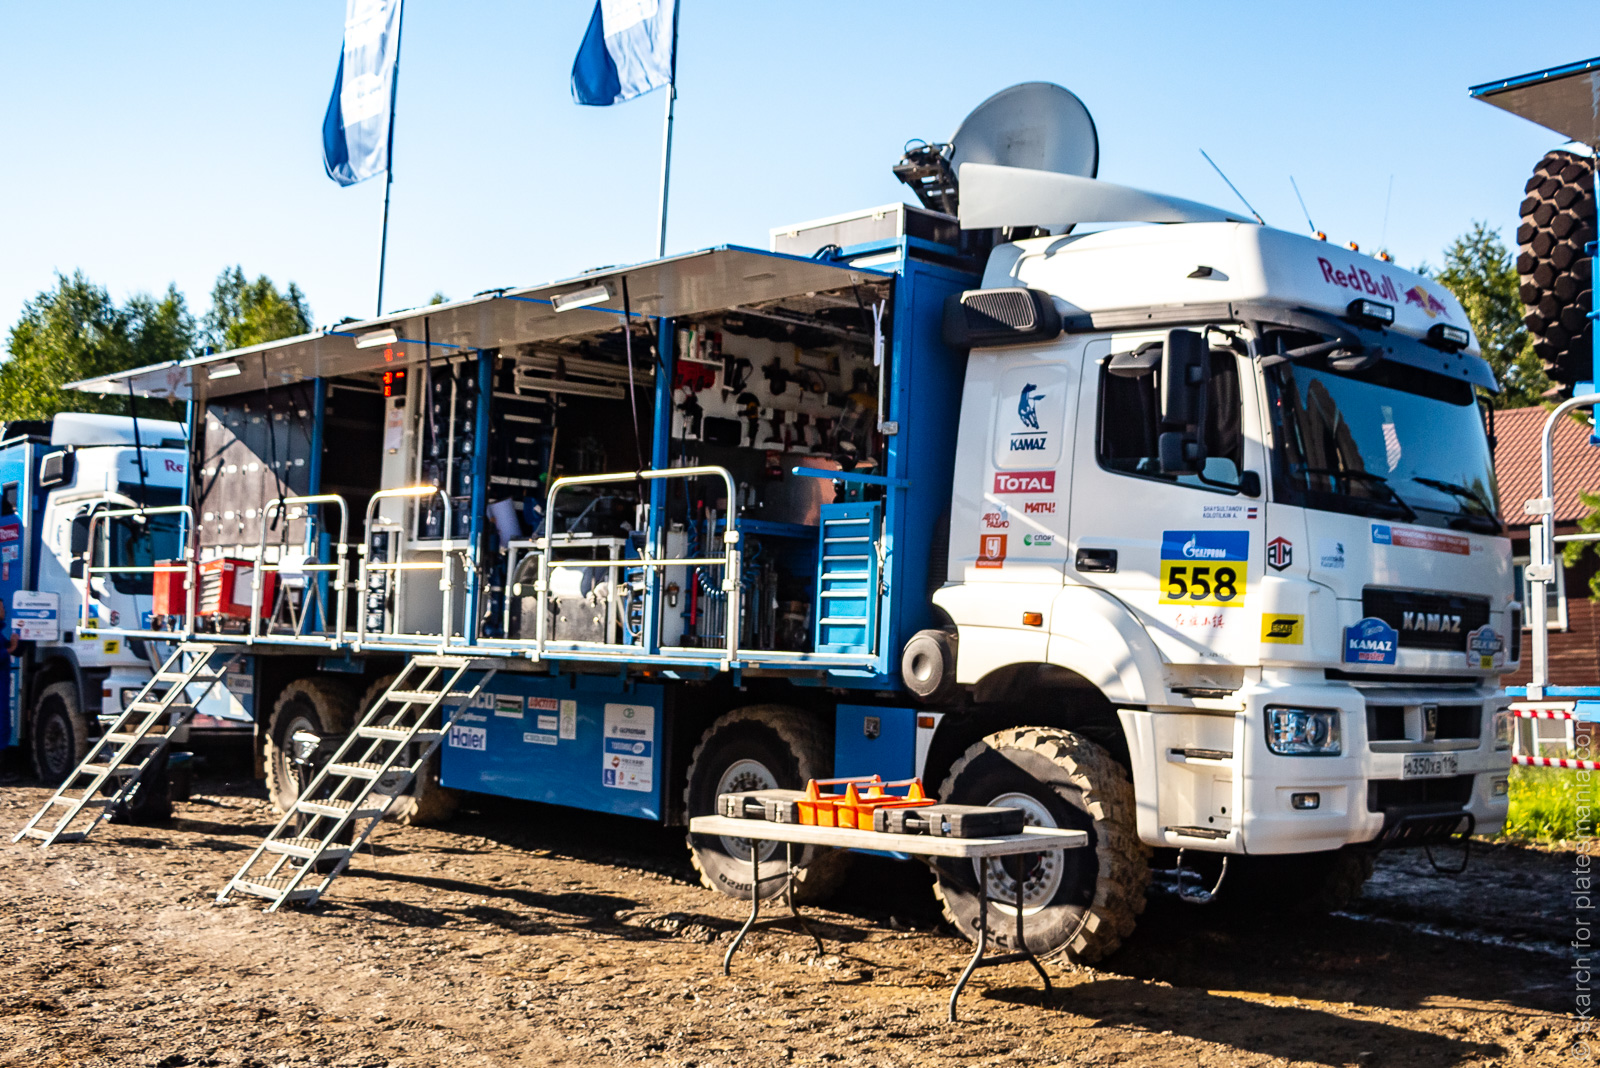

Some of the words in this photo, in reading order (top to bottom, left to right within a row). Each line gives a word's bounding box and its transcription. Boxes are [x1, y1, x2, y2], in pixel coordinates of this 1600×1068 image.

[1317, 256, 1362, 292] Red
[1358, 268, 1399, 302] Bull
[1009, 437, 1047, 451] KAMAZ
[996, 475, 1052, 491] TOTAL
[1024, 502, 1056, 513] МАТЧ!
[1194, 548, 1226, 558] GAZPROM
[1167, 566, 1237, 602] 558
[1403, 611, 1462, 633] KAMAZ
[1350, 639, 1392, 651] KAMAZ
[451, 726, 484, 748] Haier
